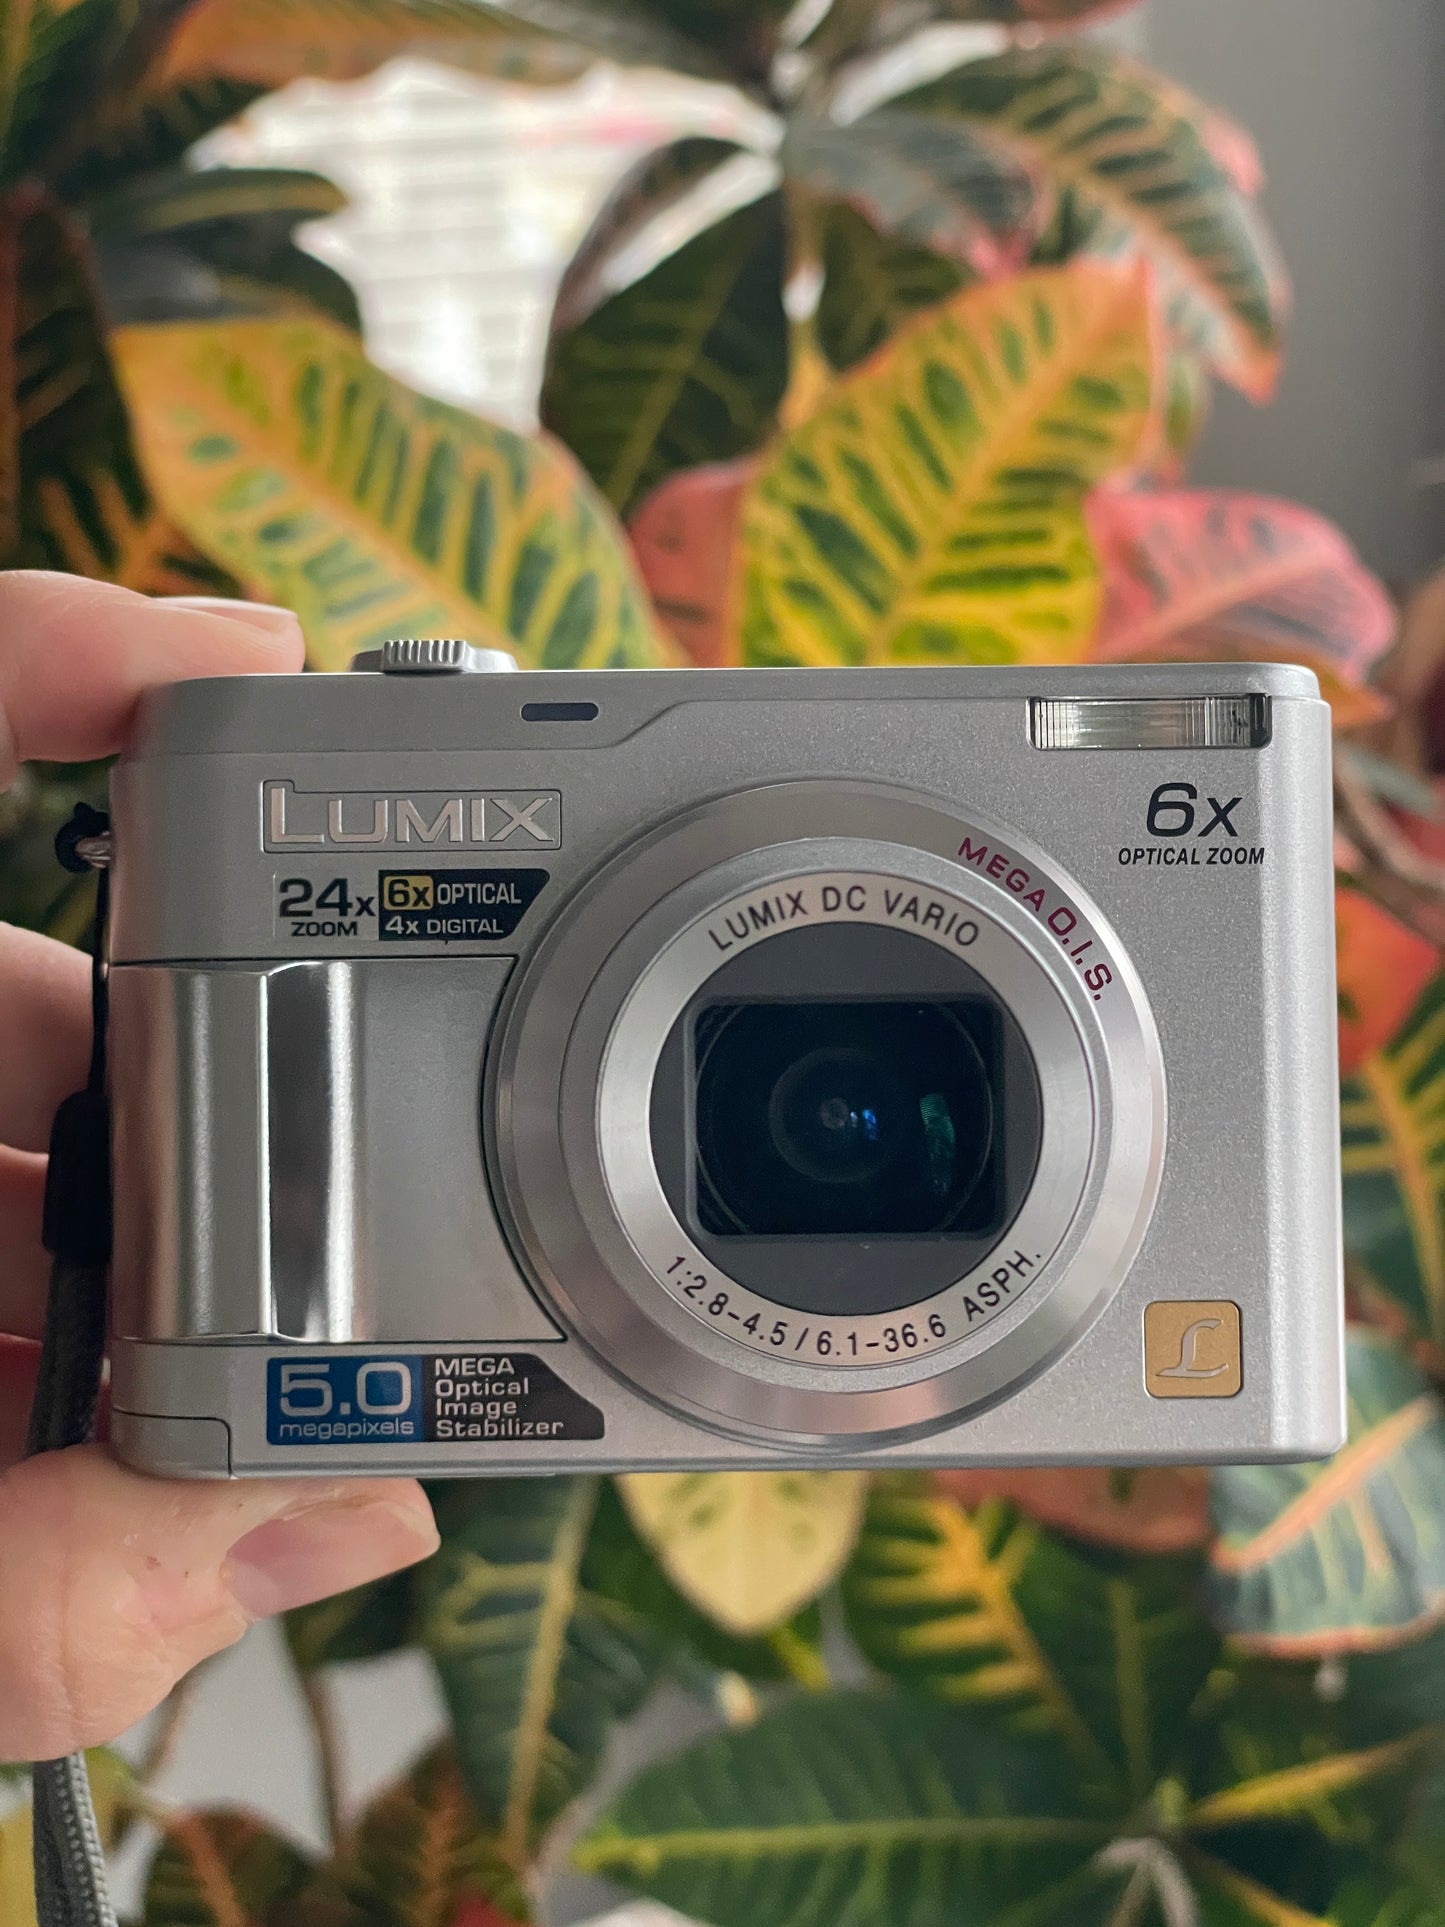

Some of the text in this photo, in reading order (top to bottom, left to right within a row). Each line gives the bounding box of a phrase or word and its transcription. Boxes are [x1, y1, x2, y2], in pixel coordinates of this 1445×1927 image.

[271, 788, 554, 843] LUMIX
[1146, 782, 1243, 838] 6x
[1118, 847, 1265, 865] OPTICAL ZOOM
[278, 877, 377, 918] 24x
[387, 879, 522, 907] 6x OPTICAL
[291, 921, 358, 937] ZOOM
[385, 915, 504, 935] 4x DIGITAL
[708, 886, 980, 951] LUMIX DC VARIO
[958, 837, 1113, 1001] MEGA O.I.S.
[963, 1249, 1043, 1322] ASPH.
[434, 1357, 515, 1376] MEGA
[280, 1361, 412, 1418] 5.0
[434, 1378, 529, 1399] Optical
[435, 1400, 518, 1420] Image
[279, 1417, 414, 1440] megapixels
[435, 1418, 564, 1438] Stabilizer
